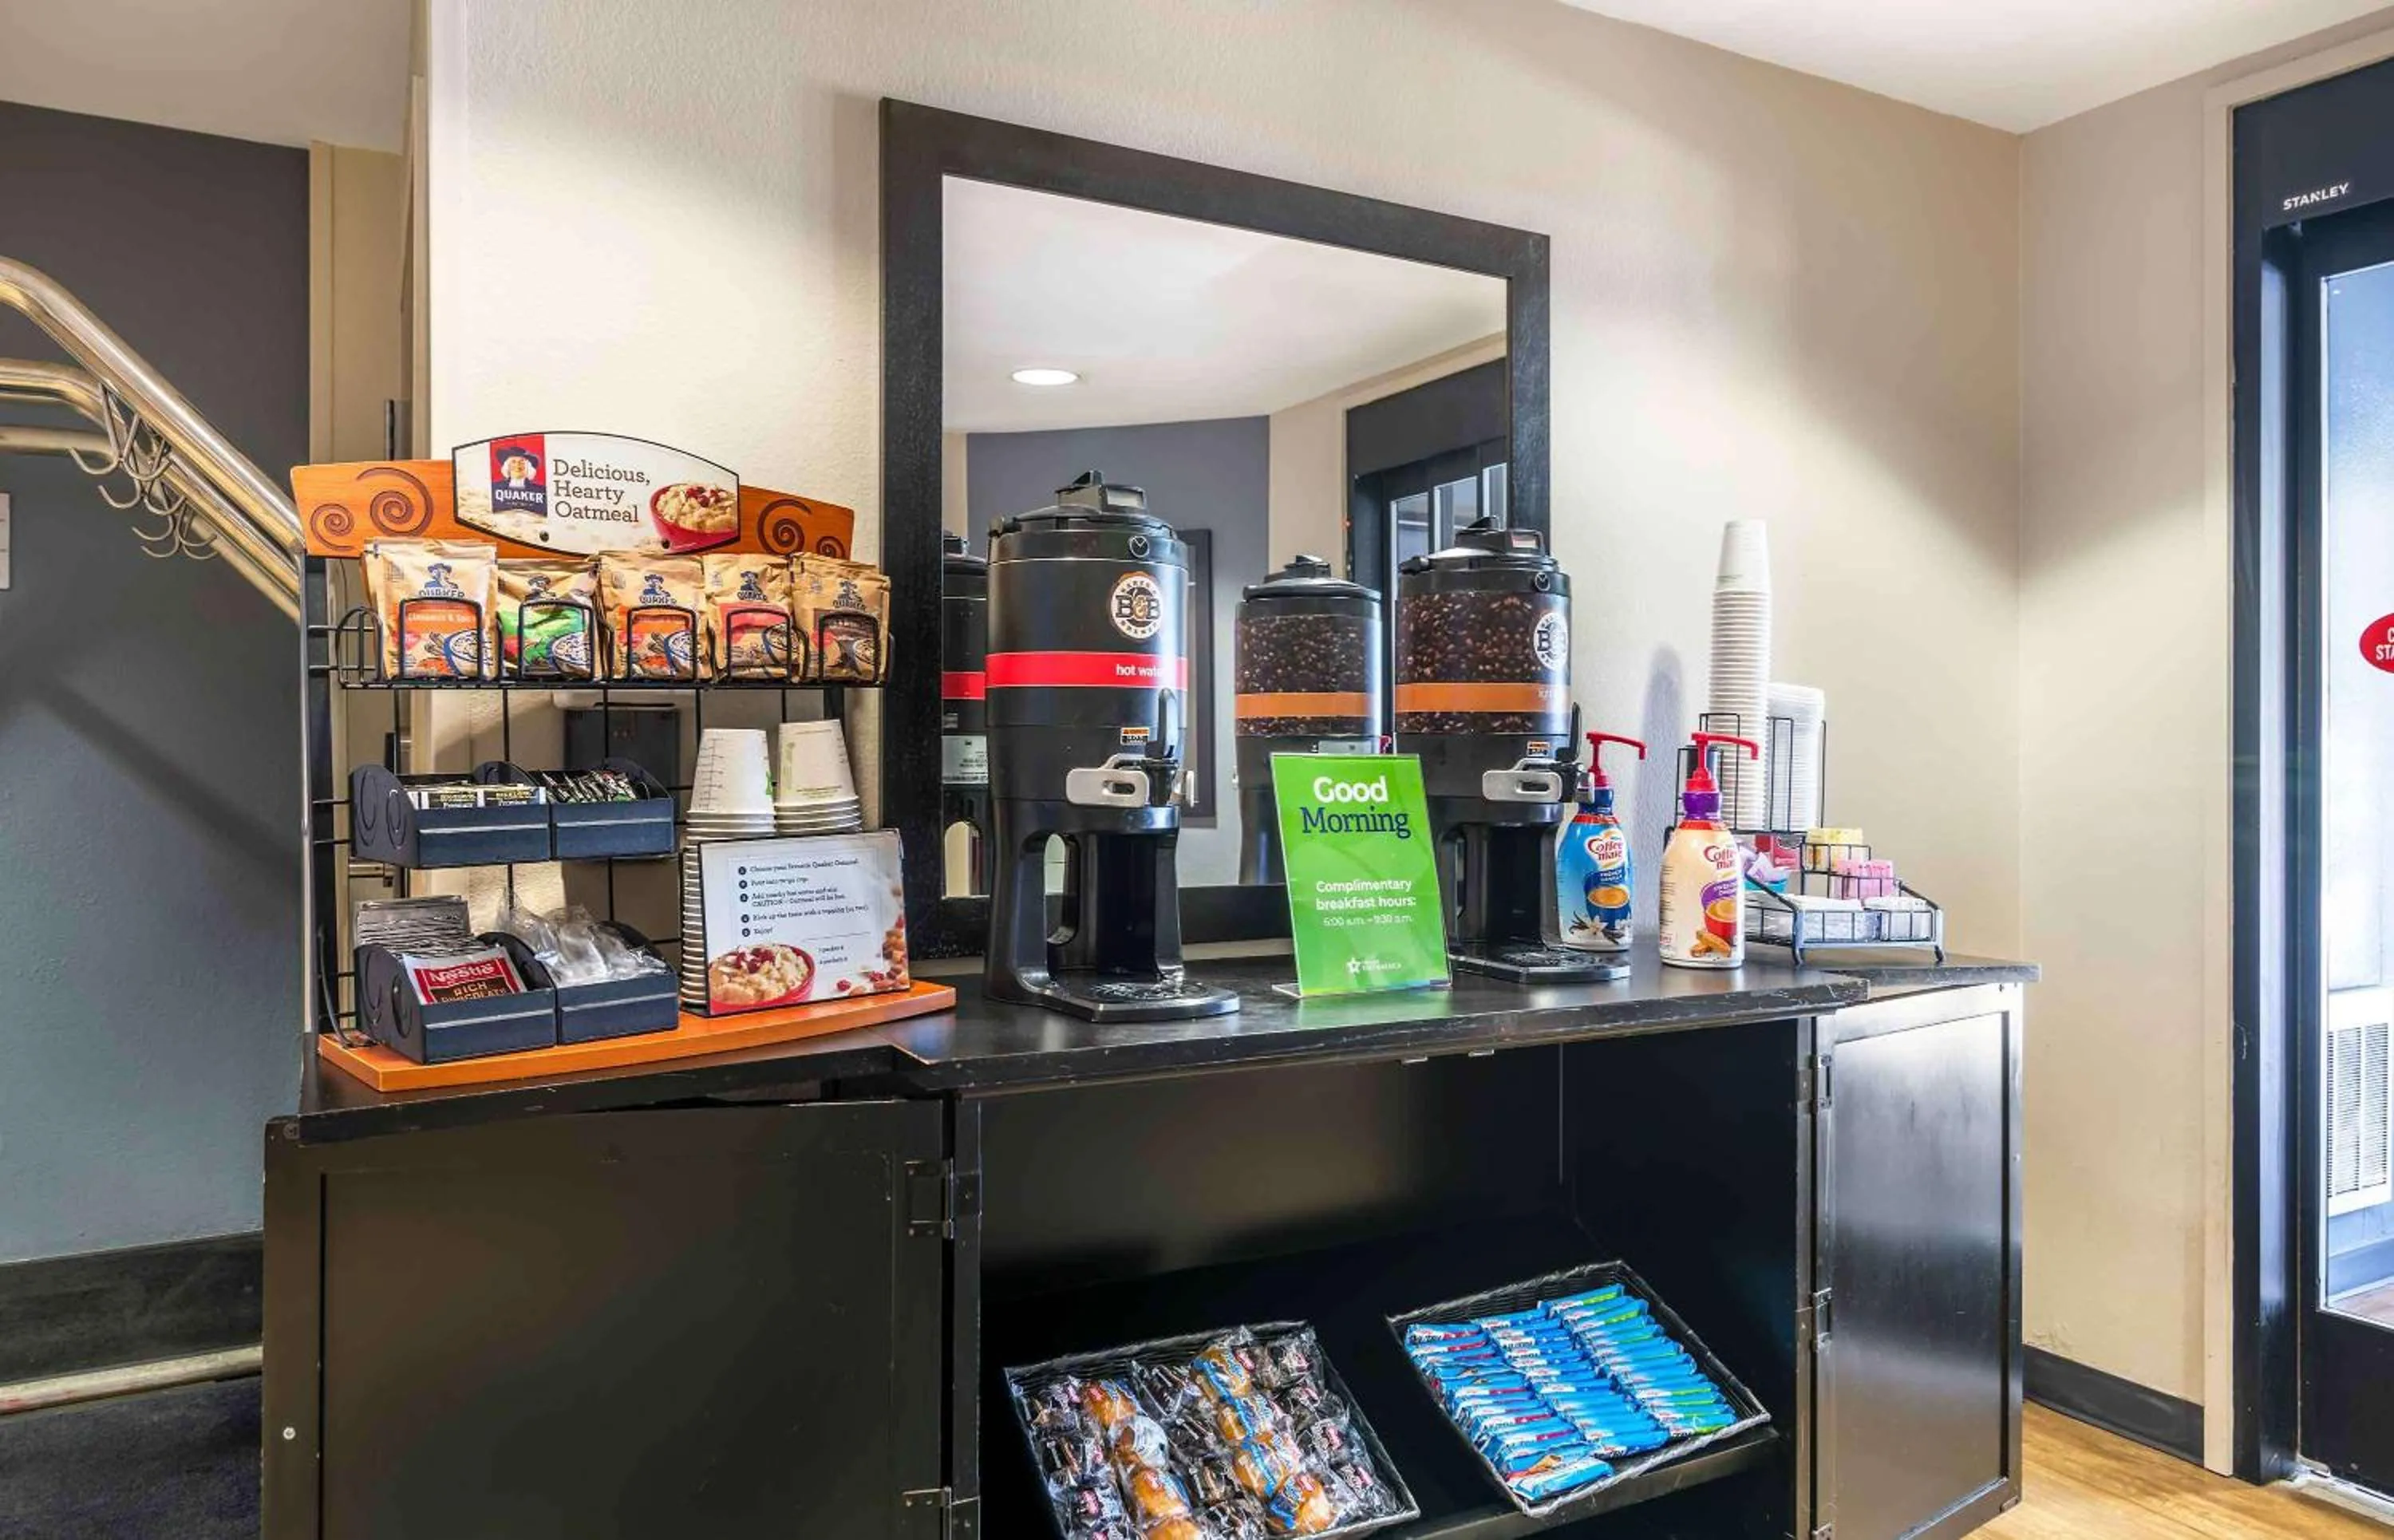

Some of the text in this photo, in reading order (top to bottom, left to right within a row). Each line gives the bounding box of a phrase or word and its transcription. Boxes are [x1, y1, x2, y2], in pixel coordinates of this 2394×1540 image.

[2283, 182, 2349, 211] STANLEY
[552, 459, 650, 486] Delicious,
[496, 489, 544, 503] QUAKER
[553, 480, 625, 505] Hearty
[555, 501, 639, 523] Oatmeal
[1116, 663, 1137, 677] hot
[1314, 775, 1389, 804] Good
[1300, 805, 1412, 839] Morning
[1587, 837, 1623, 855] Coffee
[1598, 851, 1622, 861] mate
[1316, 879, 1412, 894] Complimentary
[1316, 895, 1416, 910] breakfast hours:
[453, 981, 488, 997] RICH
